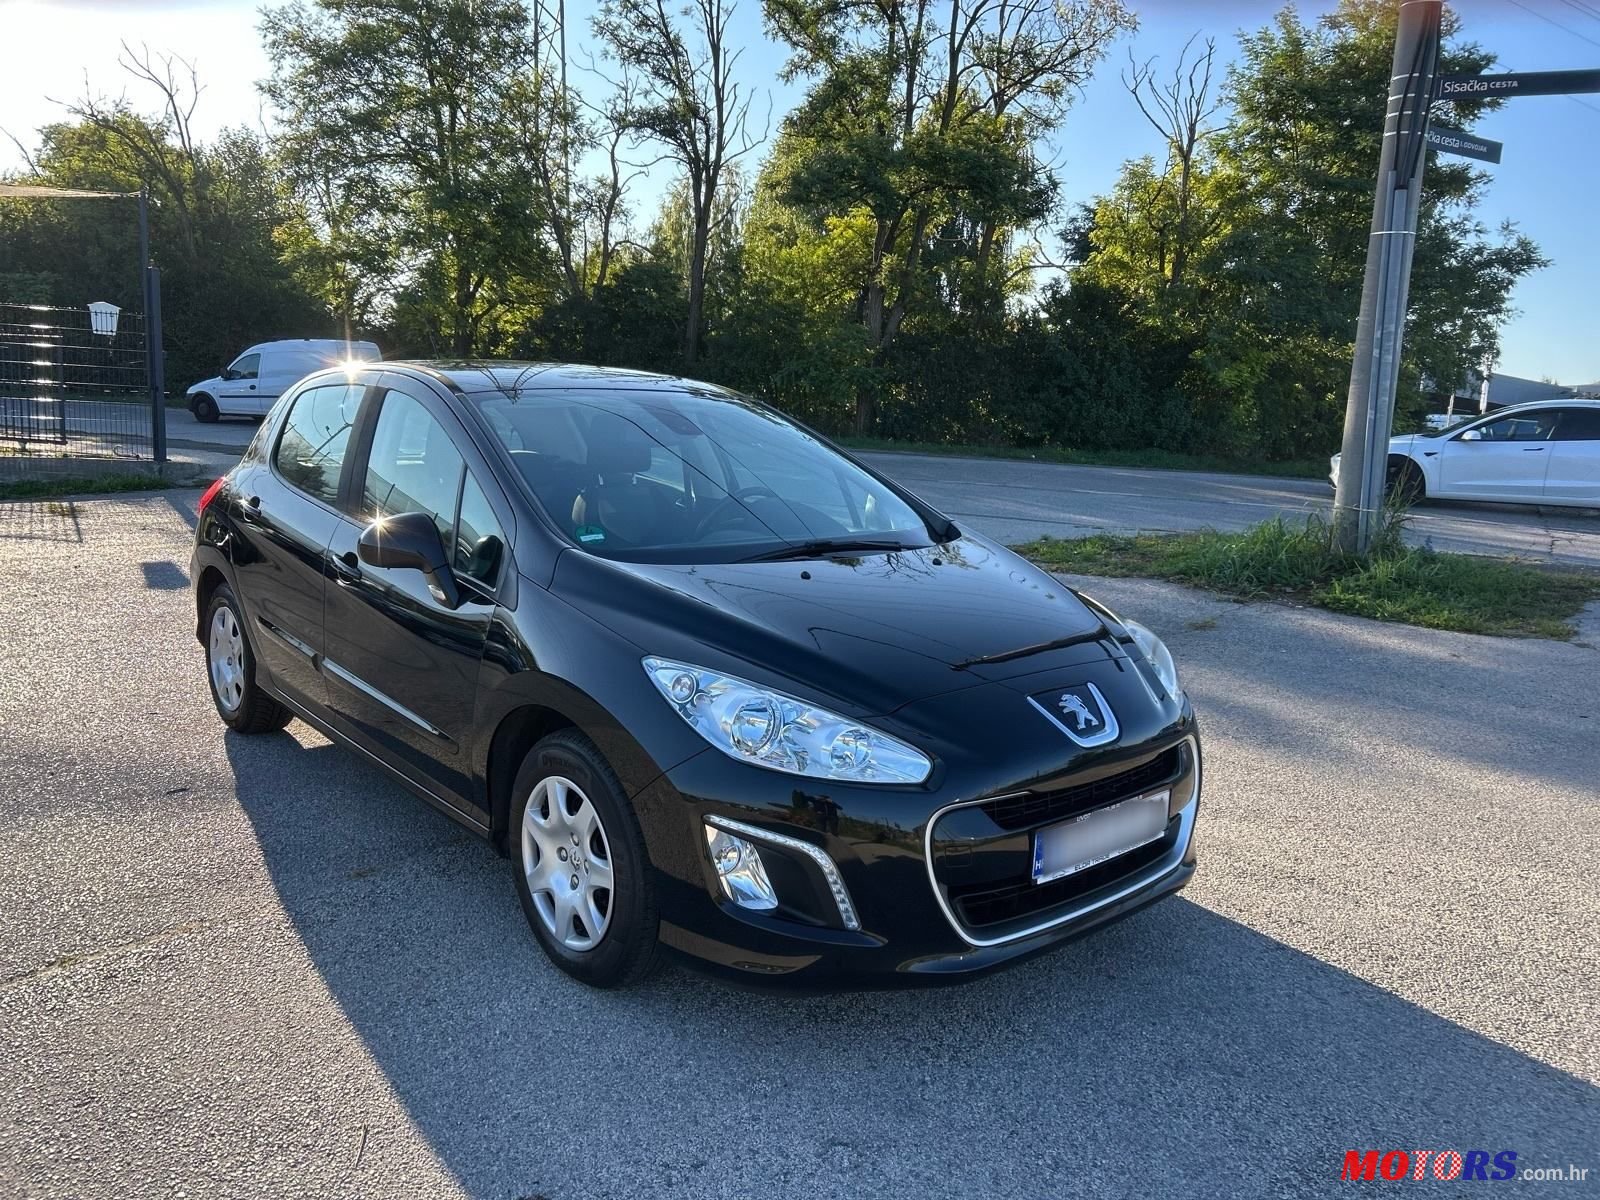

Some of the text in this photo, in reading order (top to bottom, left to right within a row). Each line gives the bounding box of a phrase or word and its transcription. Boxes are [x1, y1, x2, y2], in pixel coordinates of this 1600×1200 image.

[1443, 79, 1519, 93] Sisačka CESTA
[1441, 136, 1460, 148] cesta
